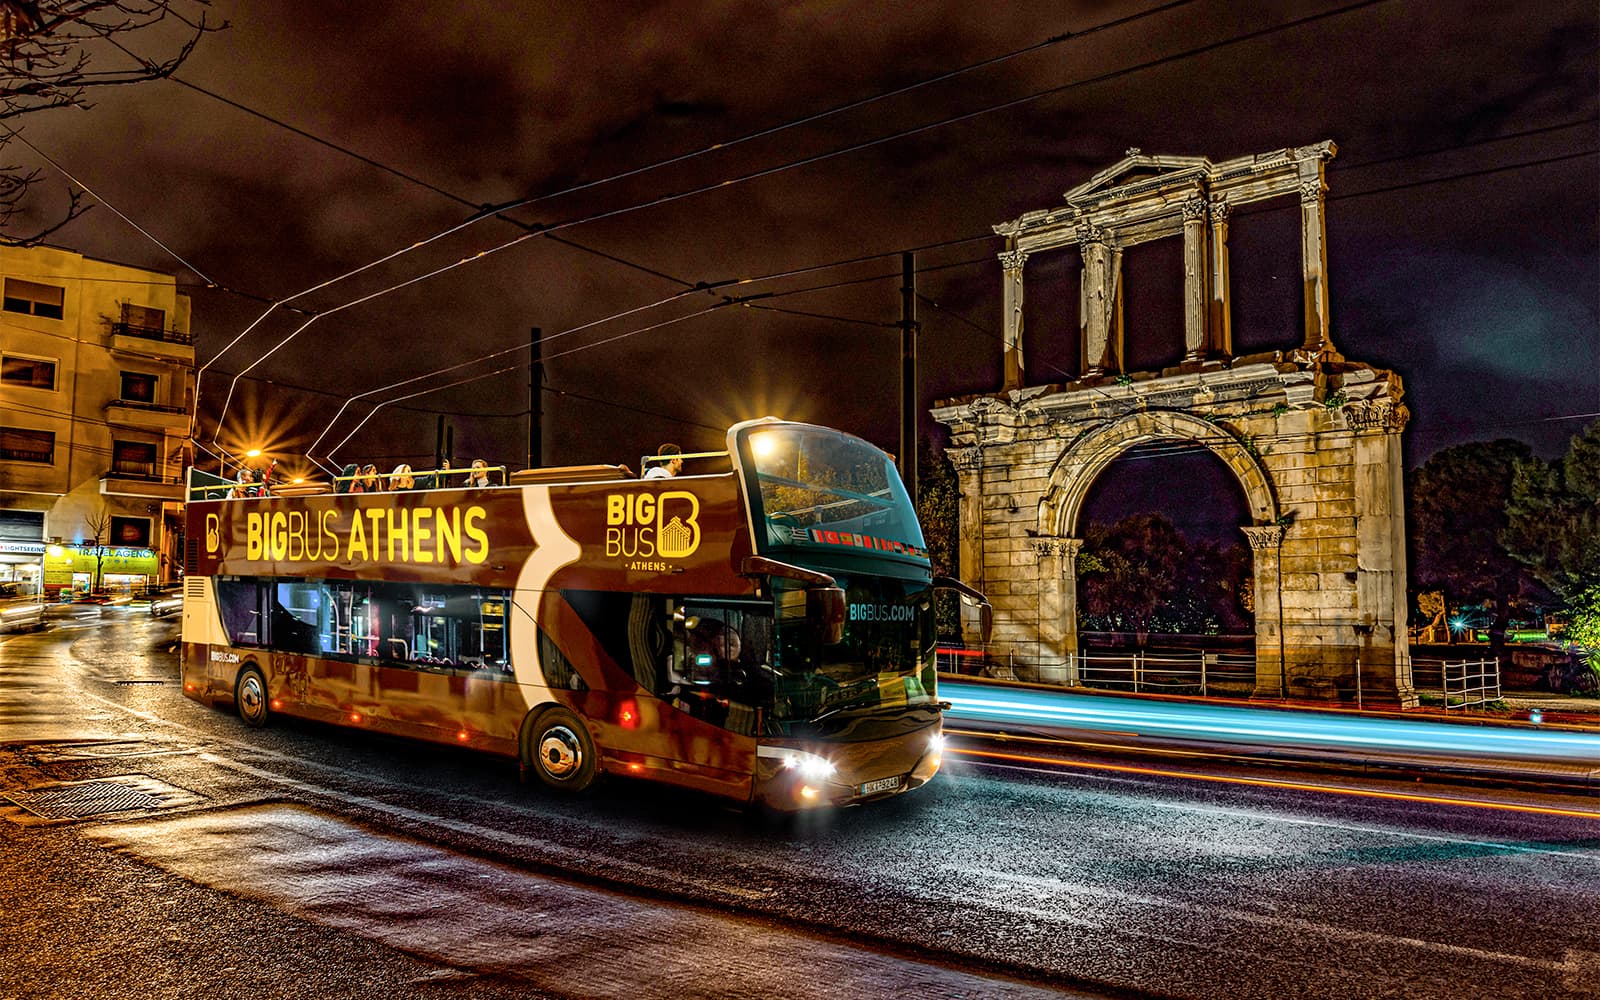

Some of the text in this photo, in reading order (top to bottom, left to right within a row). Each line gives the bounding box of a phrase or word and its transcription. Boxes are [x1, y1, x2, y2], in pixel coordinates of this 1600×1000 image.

[607, 493, 655, 525] BIG
[247, 505, 489, 565] BIGBUS ATHENS
[606, 527, 655, 558] BUS
[115, 549, 157, 559] AGENCY
[630, 561, 666, 572] ATHENS
[850, 603, 915, 621] BIGBUS.COM
